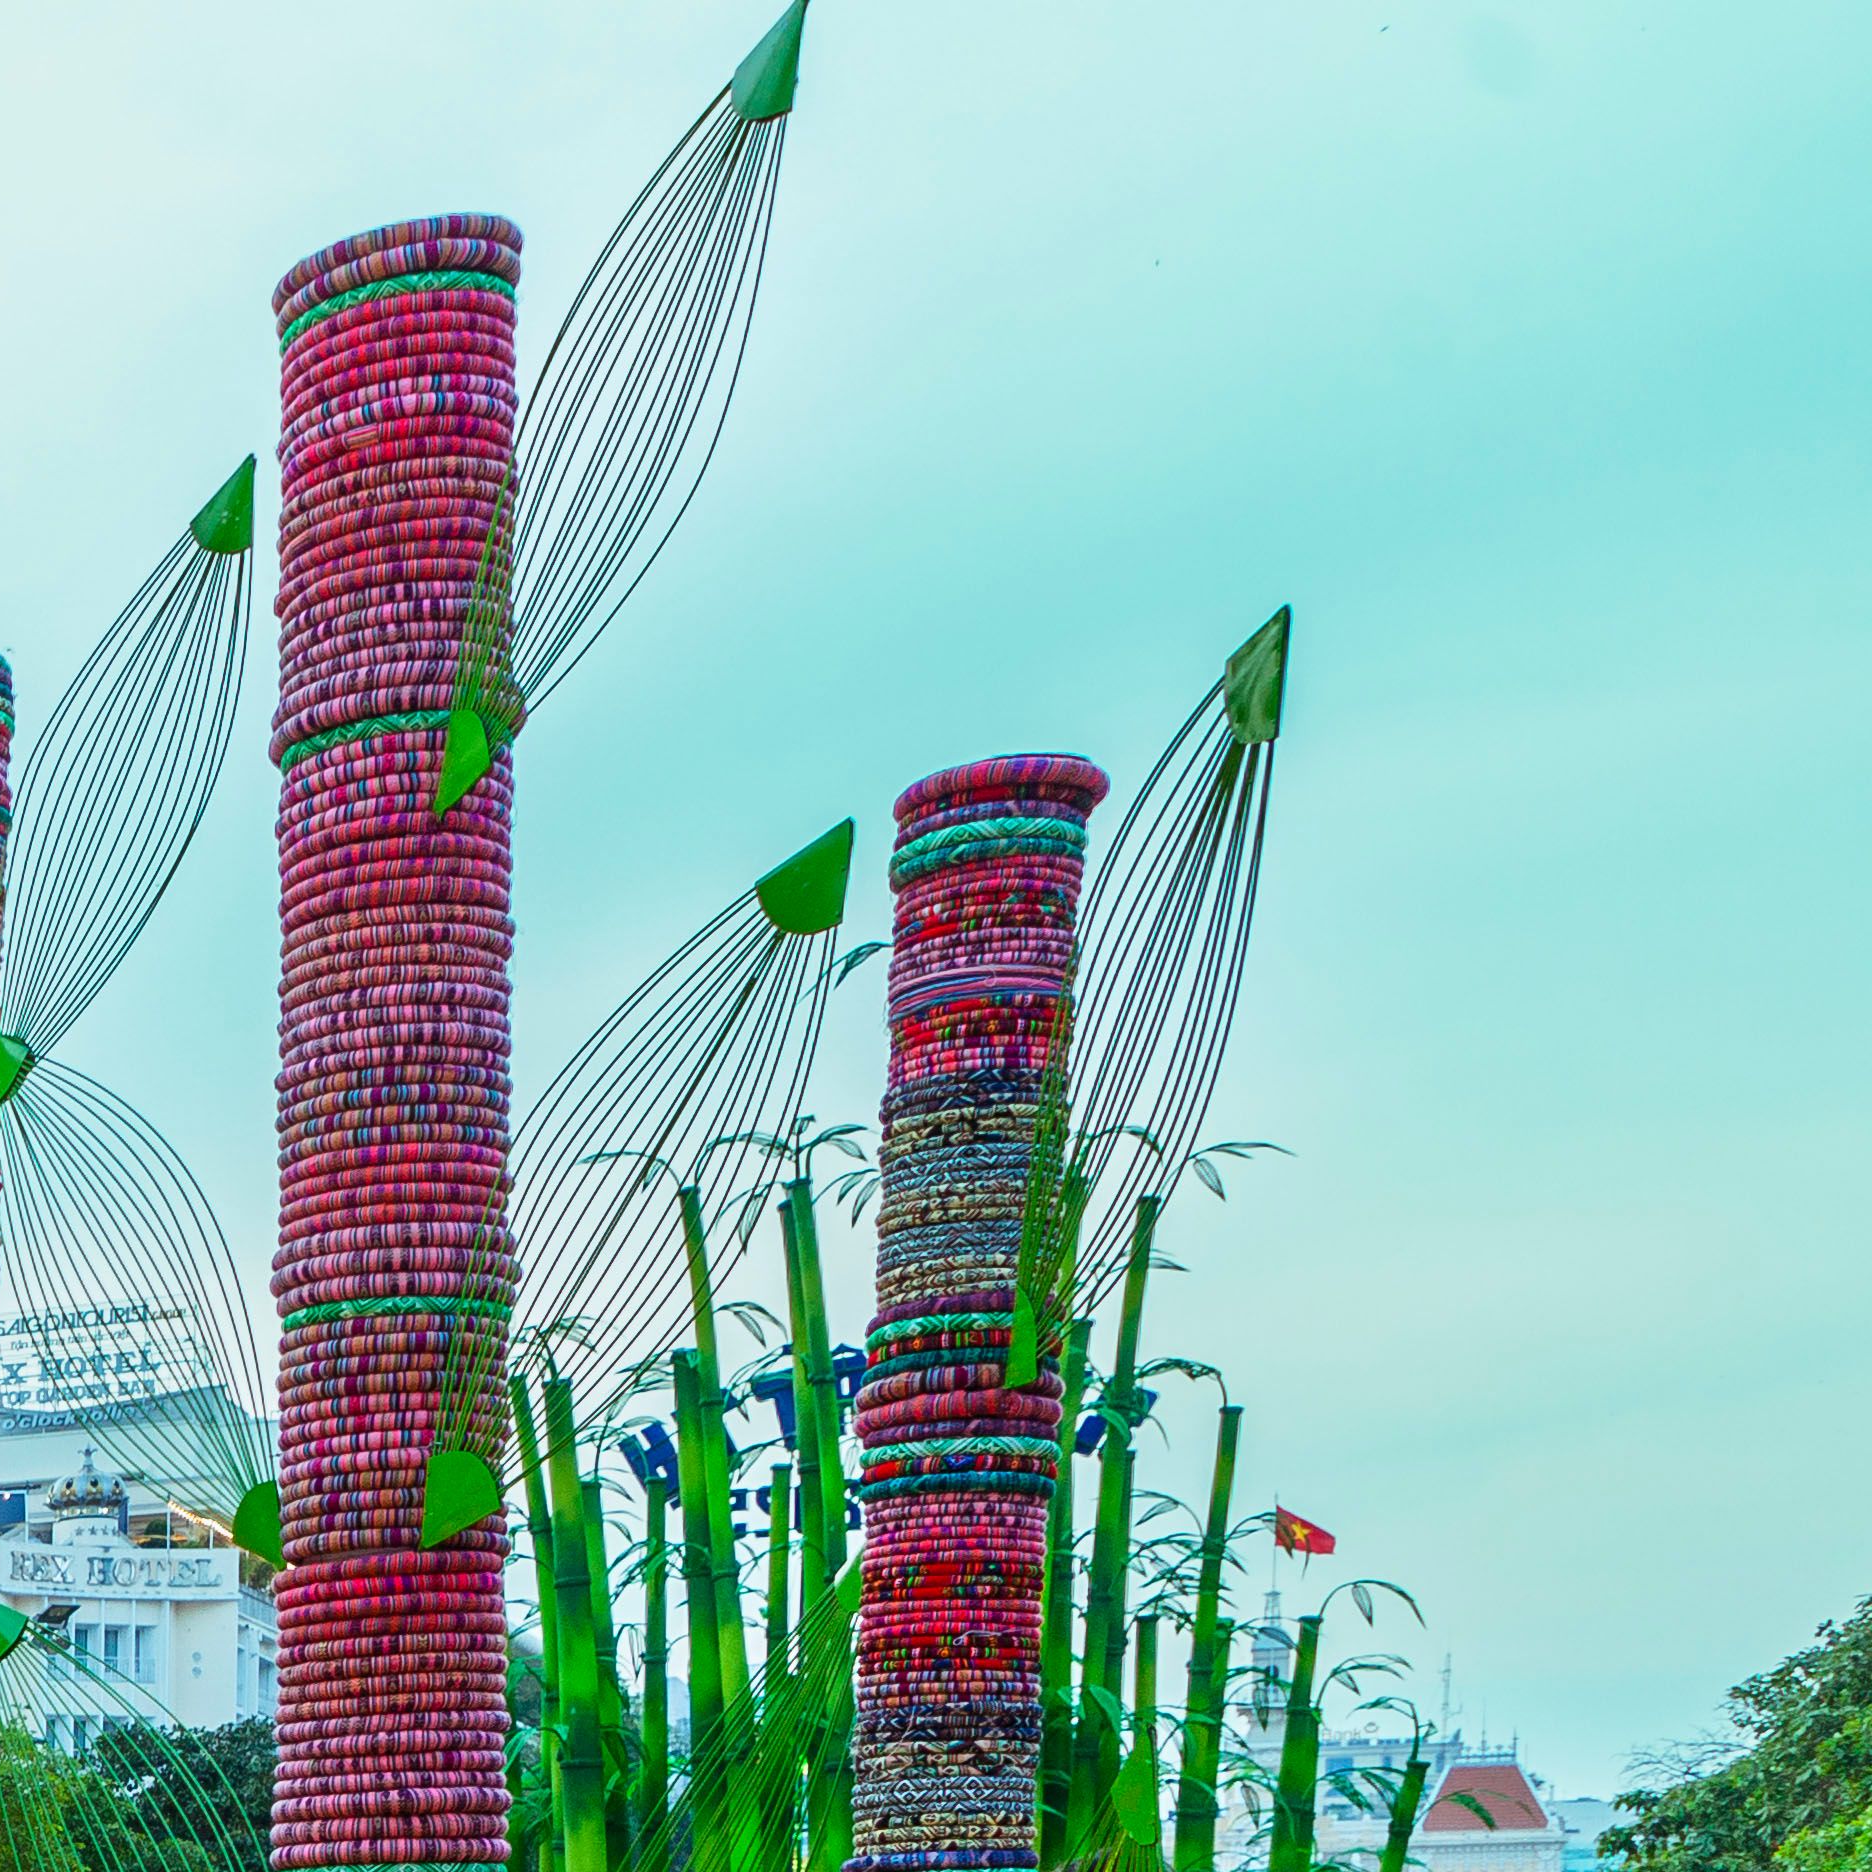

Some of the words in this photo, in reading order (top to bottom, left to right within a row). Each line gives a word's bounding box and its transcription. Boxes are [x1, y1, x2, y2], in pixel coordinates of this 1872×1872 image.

[38, 1351, 161, 1382] HOTEL
[9, 1551, 76, 1585] REX
[87, 1556, 224, 1588] HOTEL
